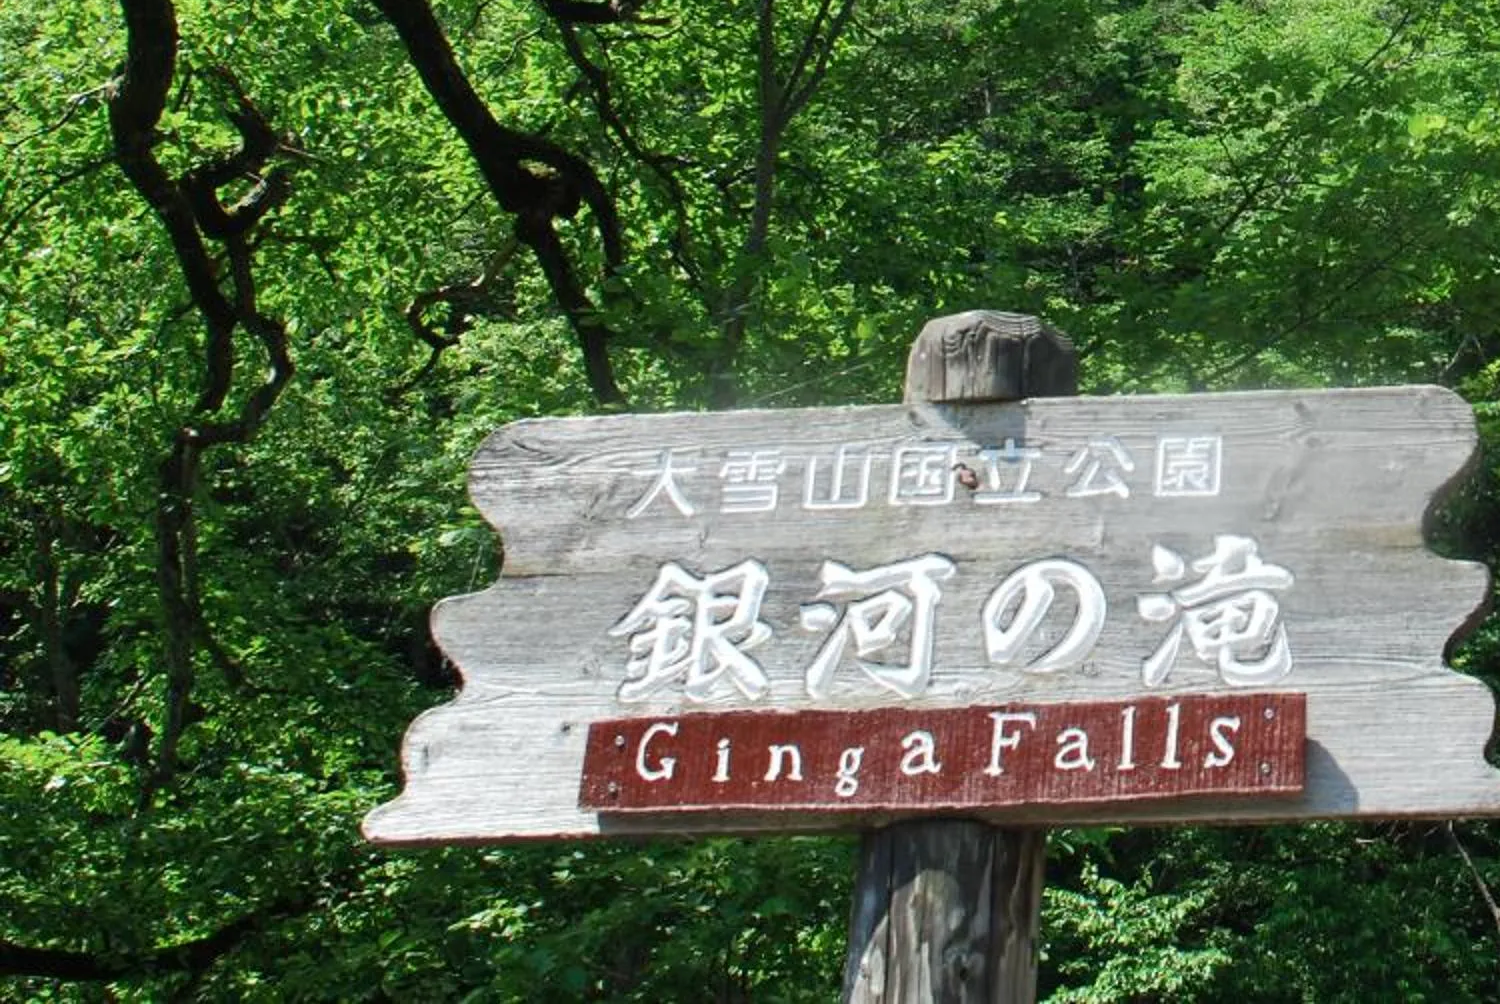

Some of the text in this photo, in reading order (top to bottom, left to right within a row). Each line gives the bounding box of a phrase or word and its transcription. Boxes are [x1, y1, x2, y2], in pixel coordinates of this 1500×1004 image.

[629, 435, 1223, 518] 大雪山国立公園
[610, 534, 1293, 702] 銀河の滝
[635, 705, 1242, 797] Ginga Falls
